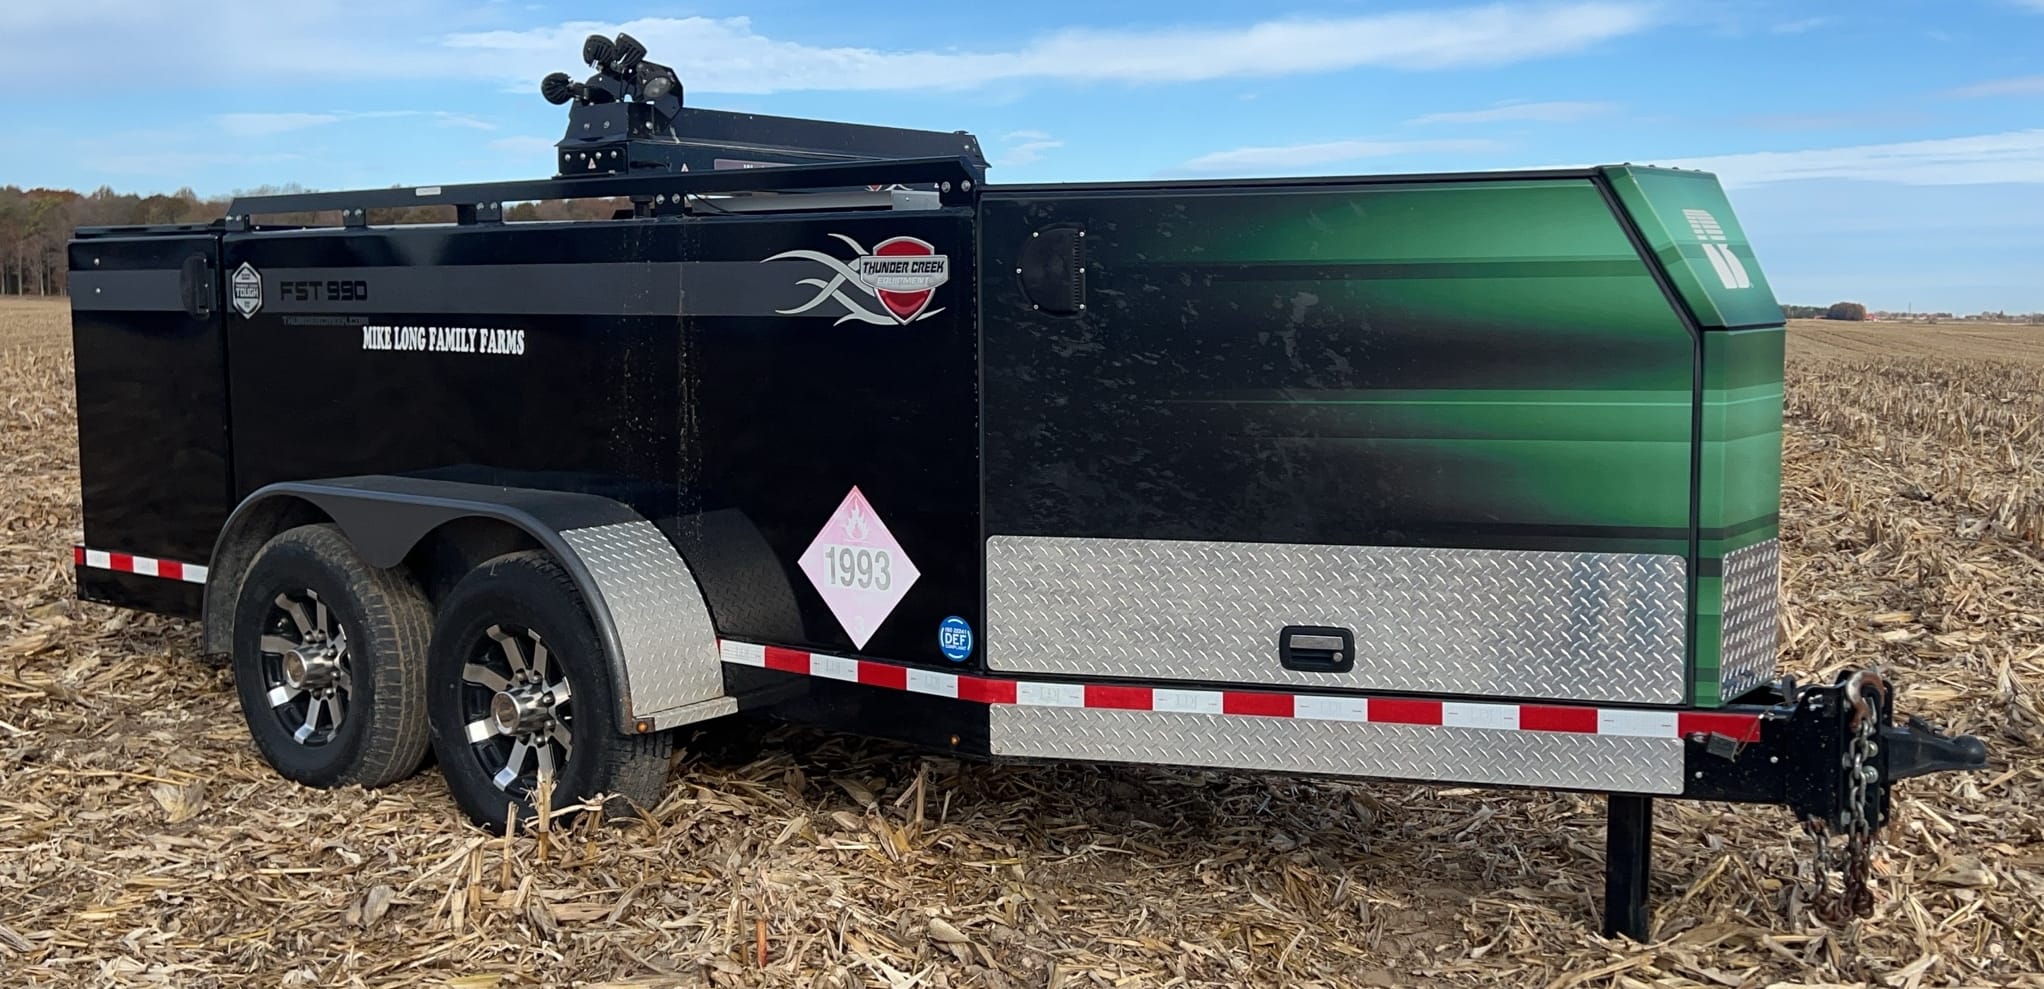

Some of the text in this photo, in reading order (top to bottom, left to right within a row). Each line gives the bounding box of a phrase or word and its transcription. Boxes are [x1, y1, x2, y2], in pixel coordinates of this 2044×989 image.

[863, 260, 945, 275] THUNDER CREEK
[877, 276, 929, 287] EQUIPMENT
[235, 287, 259, 297] TOUGH
[280, 280, 367, 301] FST 990
[363, 326, 525, 355] MIKE LONG FAMILY FARMS
[825, 546, 891, 591] 1993
[945, 632, 967, 646] DEF
